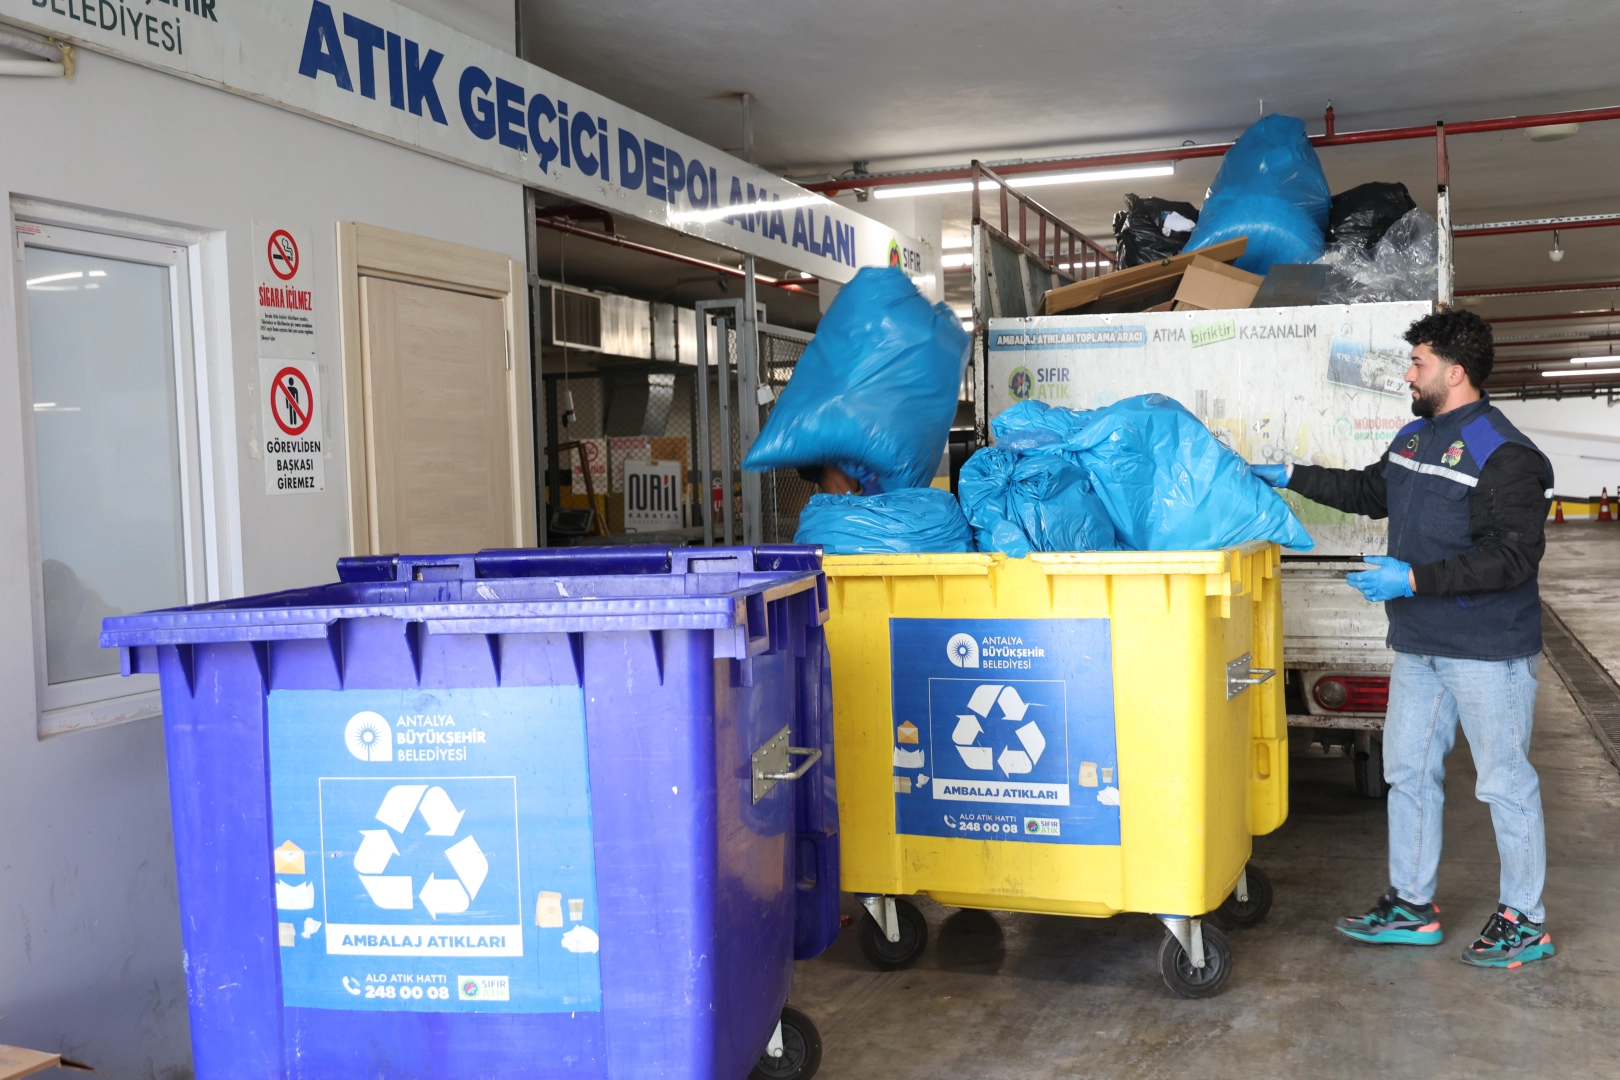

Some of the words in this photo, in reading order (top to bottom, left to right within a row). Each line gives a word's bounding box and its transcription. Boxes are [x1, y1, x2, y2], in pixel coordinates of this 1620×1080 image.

[299, 1, 448, 126] ATIK
[459, 65, 609, 182] GEÇİCİ
[618, 127, 787, 245] DEPOLAMA
[792, 207, 856, 267] ALANI
[903, 247, 921, 273] SIFIR
[259, 282, 285, 308] SİGARA
[286, 285, 312, 311] İÇİLMEZ
[996, 334, 1036, 346] AMBALAJ
[1037, 333, 1074, 345] ATIKLARI
[1075, 332, 1114, 343] TOPLAMA
[1116, 331, 1143, 343] ARACI
[1153, 328, 1186, 342] ATMA
[1191, 324, 1231, 344] biriktir
[1239, 324, 1317, 340] KAZANALIM
[1037, 367, 1070, 382] SIFIR
[1037, 384, 1070, 399] ATIK
[267, 437, 321, 453] GÖREVLİDEN
[277, 458, 314, 474] BAŞKASI
[277, 475, 315, 490] GİREMEZ
[982, 636, 1023, 646] ANTALYA
[982, 645, 1045, 660] BÜYÜKŞEHİR
[982, 658, 1032, 669] BELEDİYESİ
[396, 714, 456, 727] ANTALYA
[397, 727, 487, 747] BÜYÜKŞEHİR
[397, 746, 467, 762] BELEDİYESİ
[943, 786, 999, 797] AMBALAJ
[1002, 789, 1058, 800] ATIKLARI
[959, 822, 980, 831] 248
[983, 823, 1000, 833] 00
[1002, 823, 1018, 834] 08
[341, 934, 422, 948] AMBALAJ
[427, 935, 506, 948] ATIKLARI
[365, 973, 387, 983] ALO
[390, 974, 413, 983] ATIK
[416, 974, 447, 984] HATTI
[481, 979, 506, 988] SIFIR
[364, 985, 396, 999] 248
[399, 985, 423, 999] 00
[427, 985, 449, 1000] 08
[482, 988, 506, 998] ATIK
